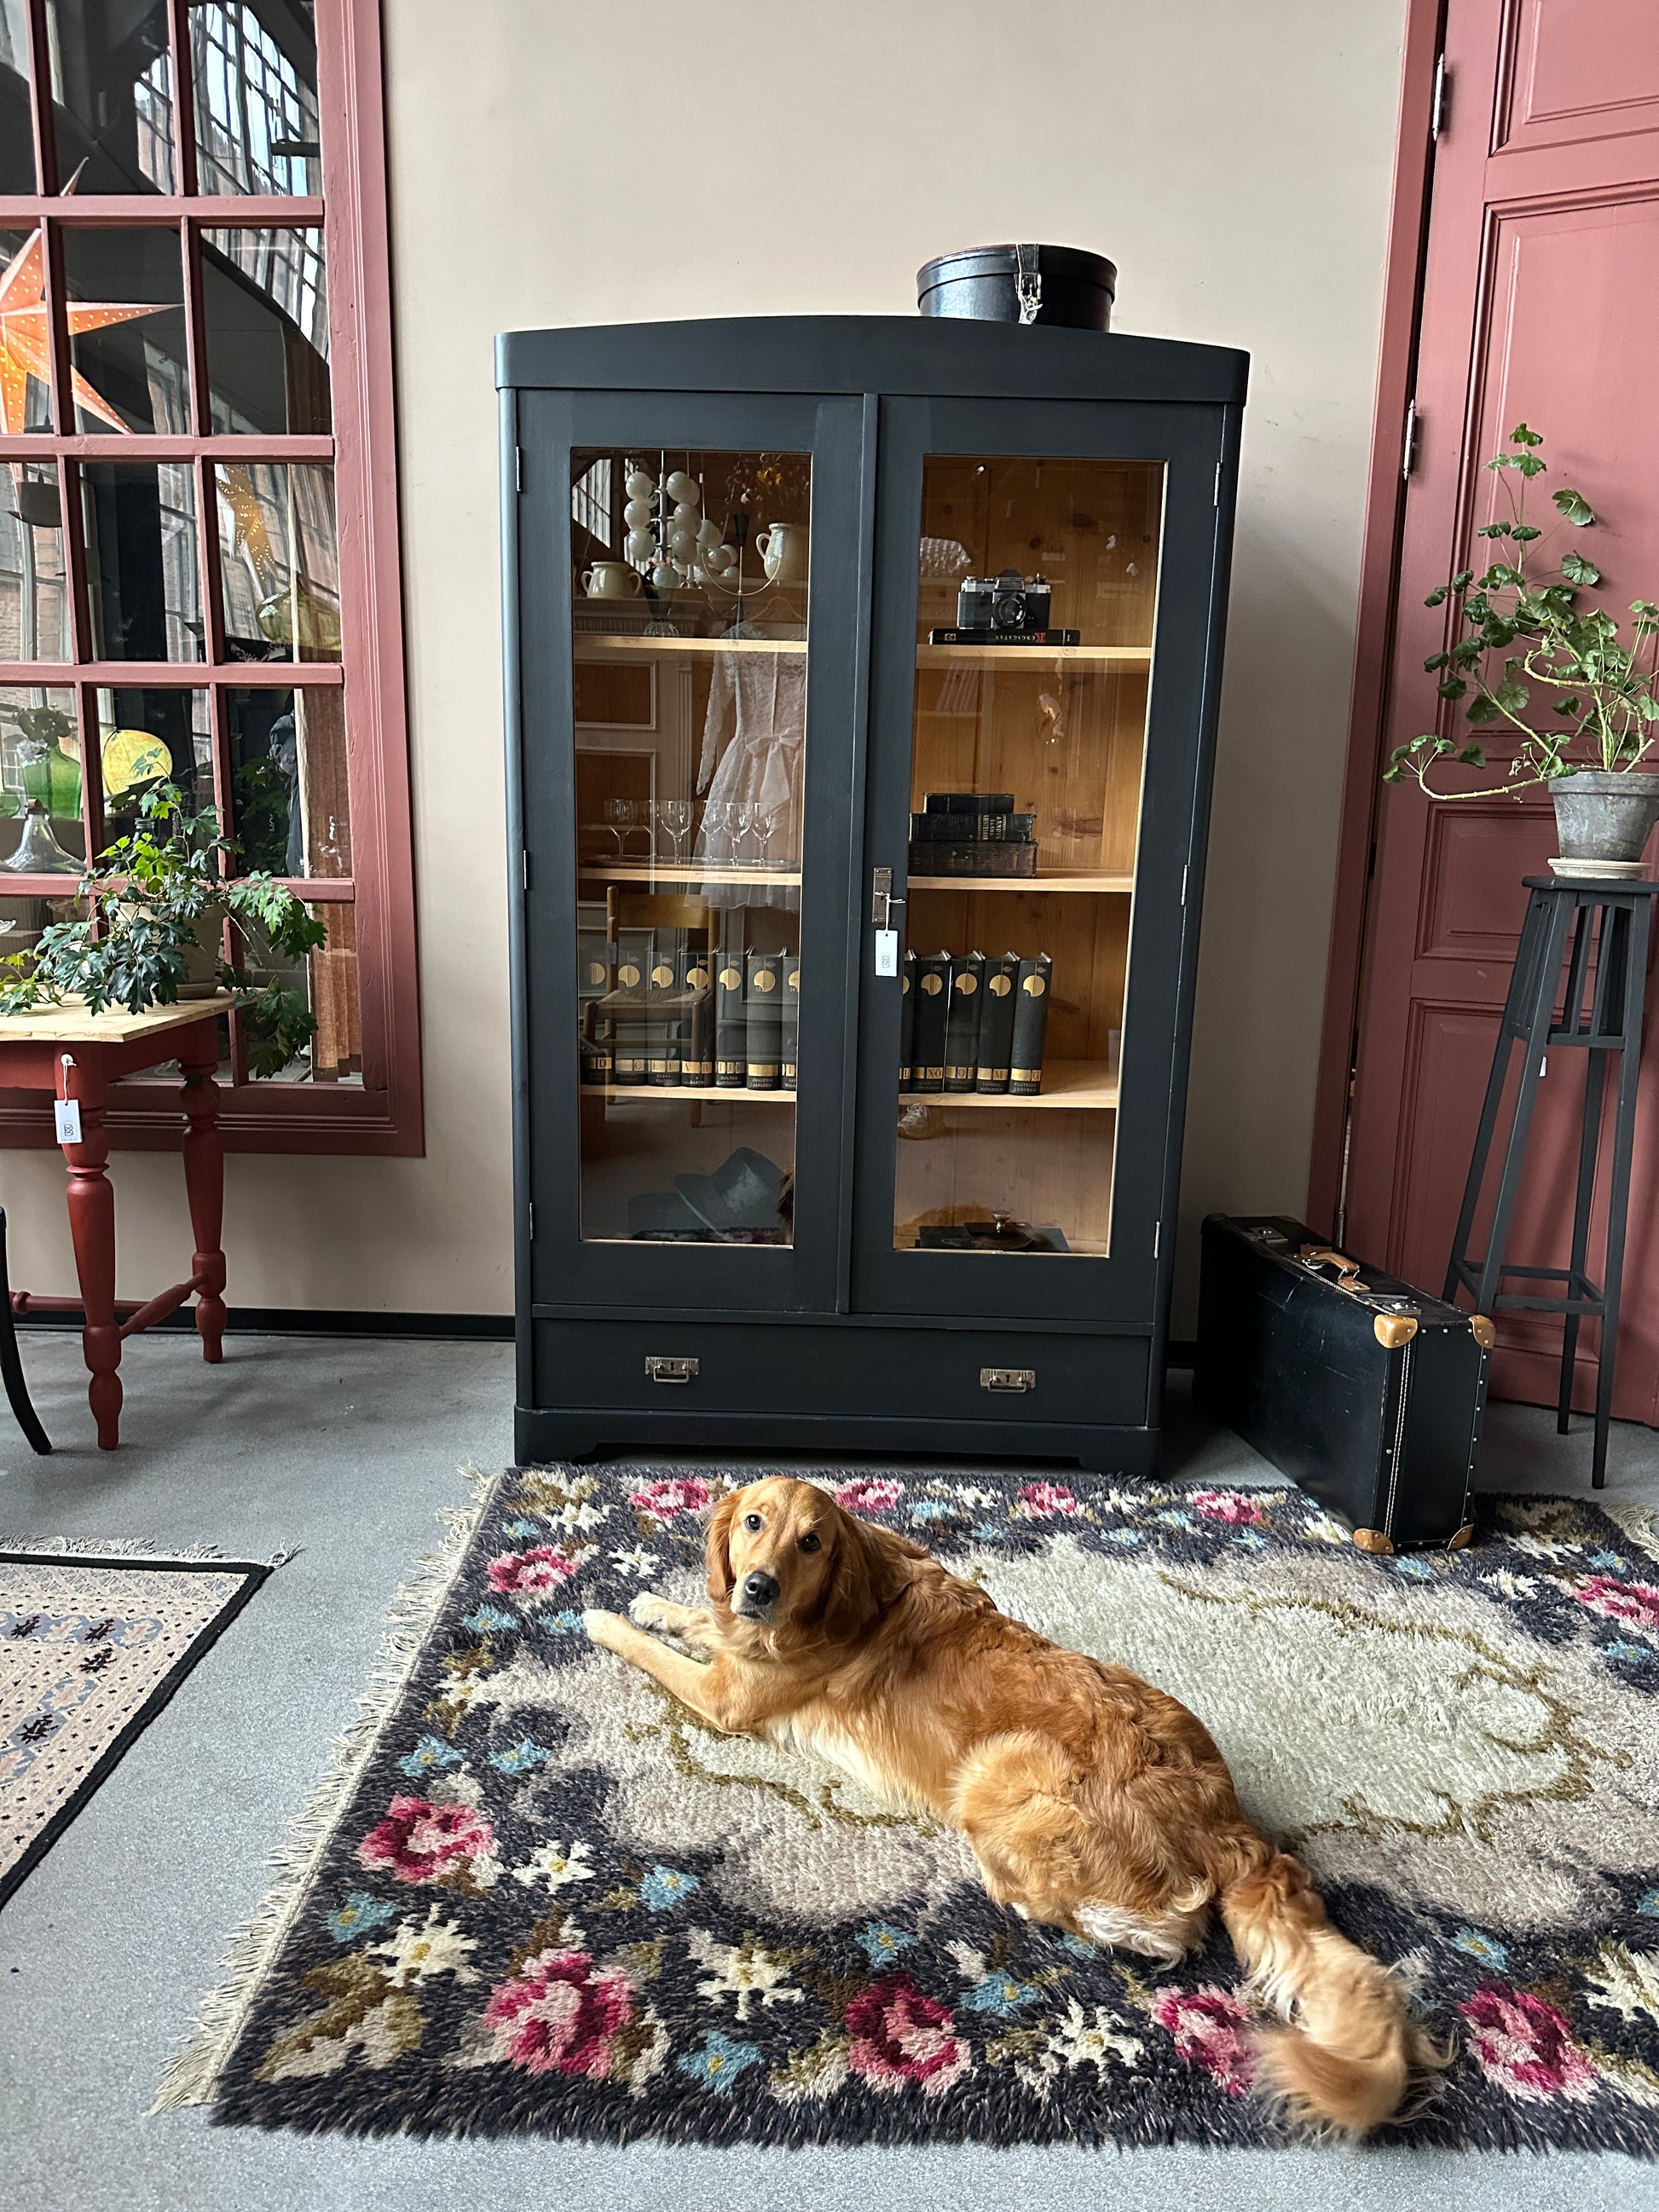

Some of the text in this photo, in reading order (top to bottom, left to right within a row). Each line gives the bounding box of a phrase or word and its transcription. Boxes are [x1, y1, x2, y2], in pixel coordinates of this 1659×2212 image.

[995, 632, 1046, 644] KUNGSGATAN
[598, 1059, 606, 1067] D
[634, 1060, 643, 1070] C
[994, 1071, 1003, 1079] M
[1032, 1071, 1040, 1080] G
[64, 1123, 74, 1136] B
